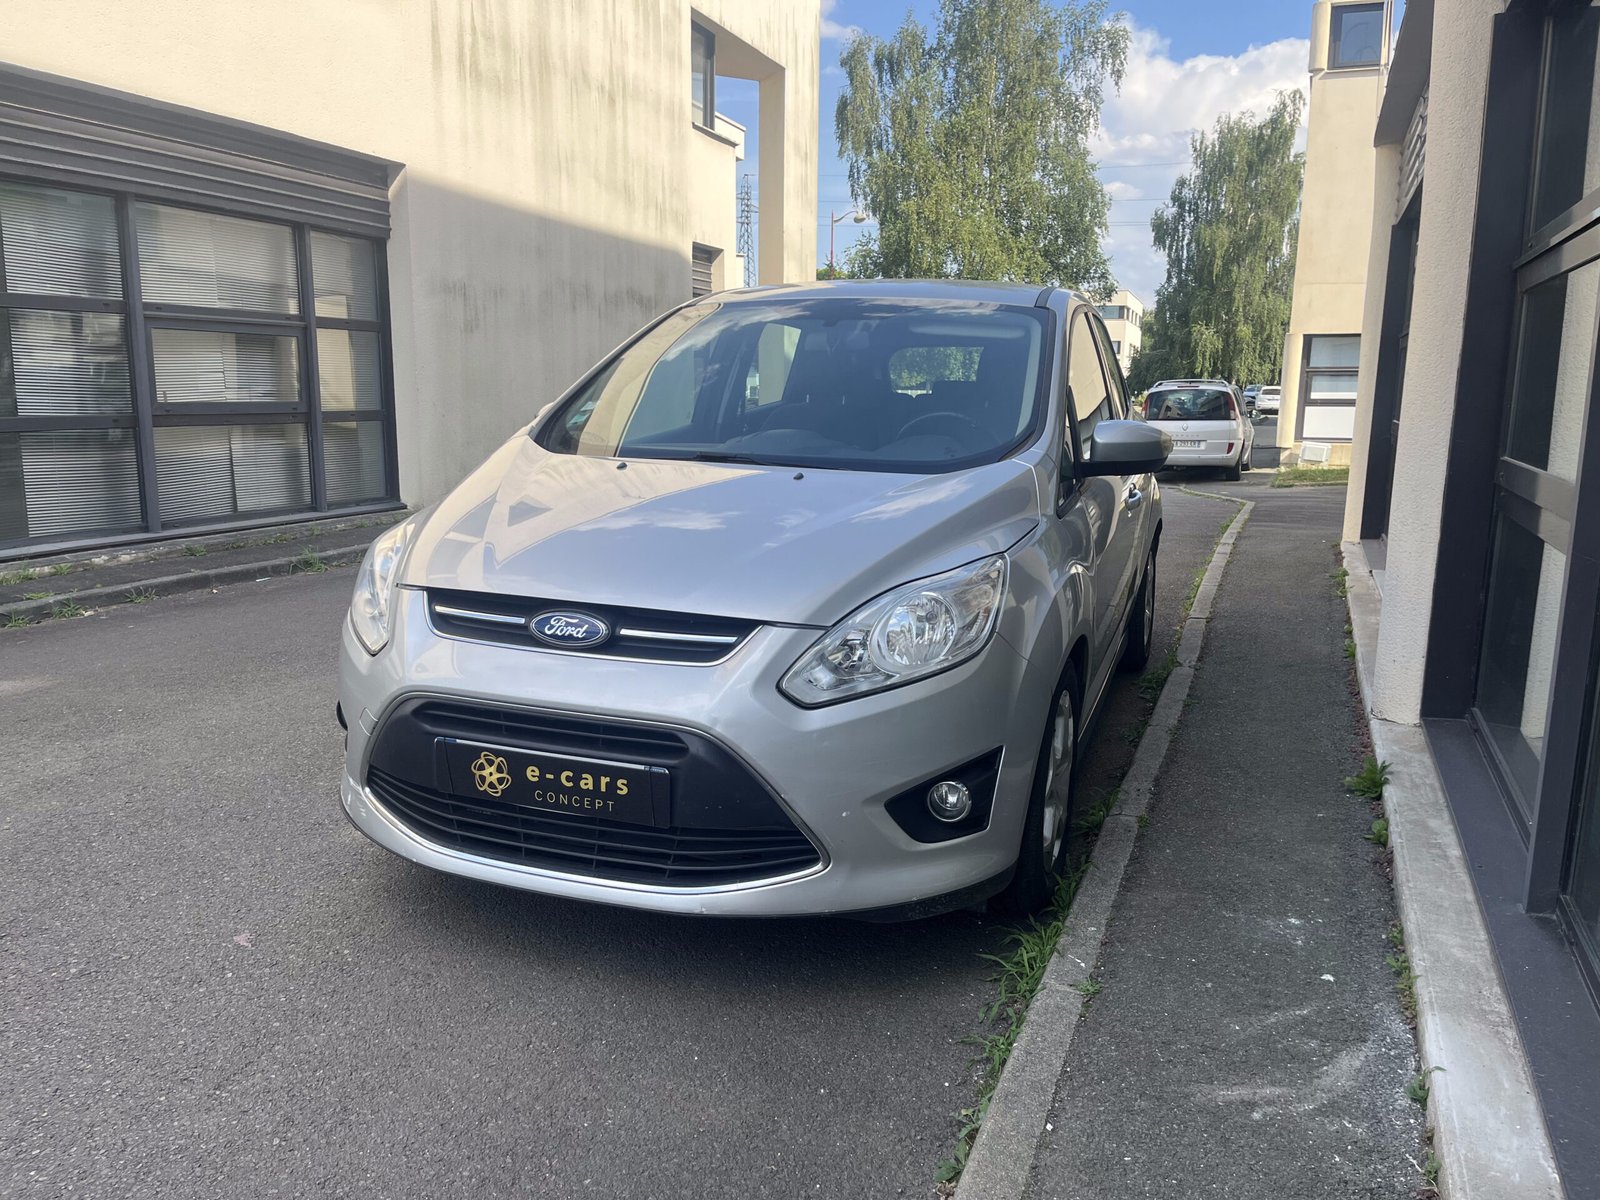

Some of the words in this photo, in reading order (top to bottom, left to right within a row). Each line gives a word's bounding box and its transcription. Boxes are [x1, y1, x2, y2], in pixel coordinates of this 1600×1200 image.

[544, 616, 589, 638] Ford
[526, 766, 629, 795] e-cars
[535, 790, 614, 812] CONCEPT
